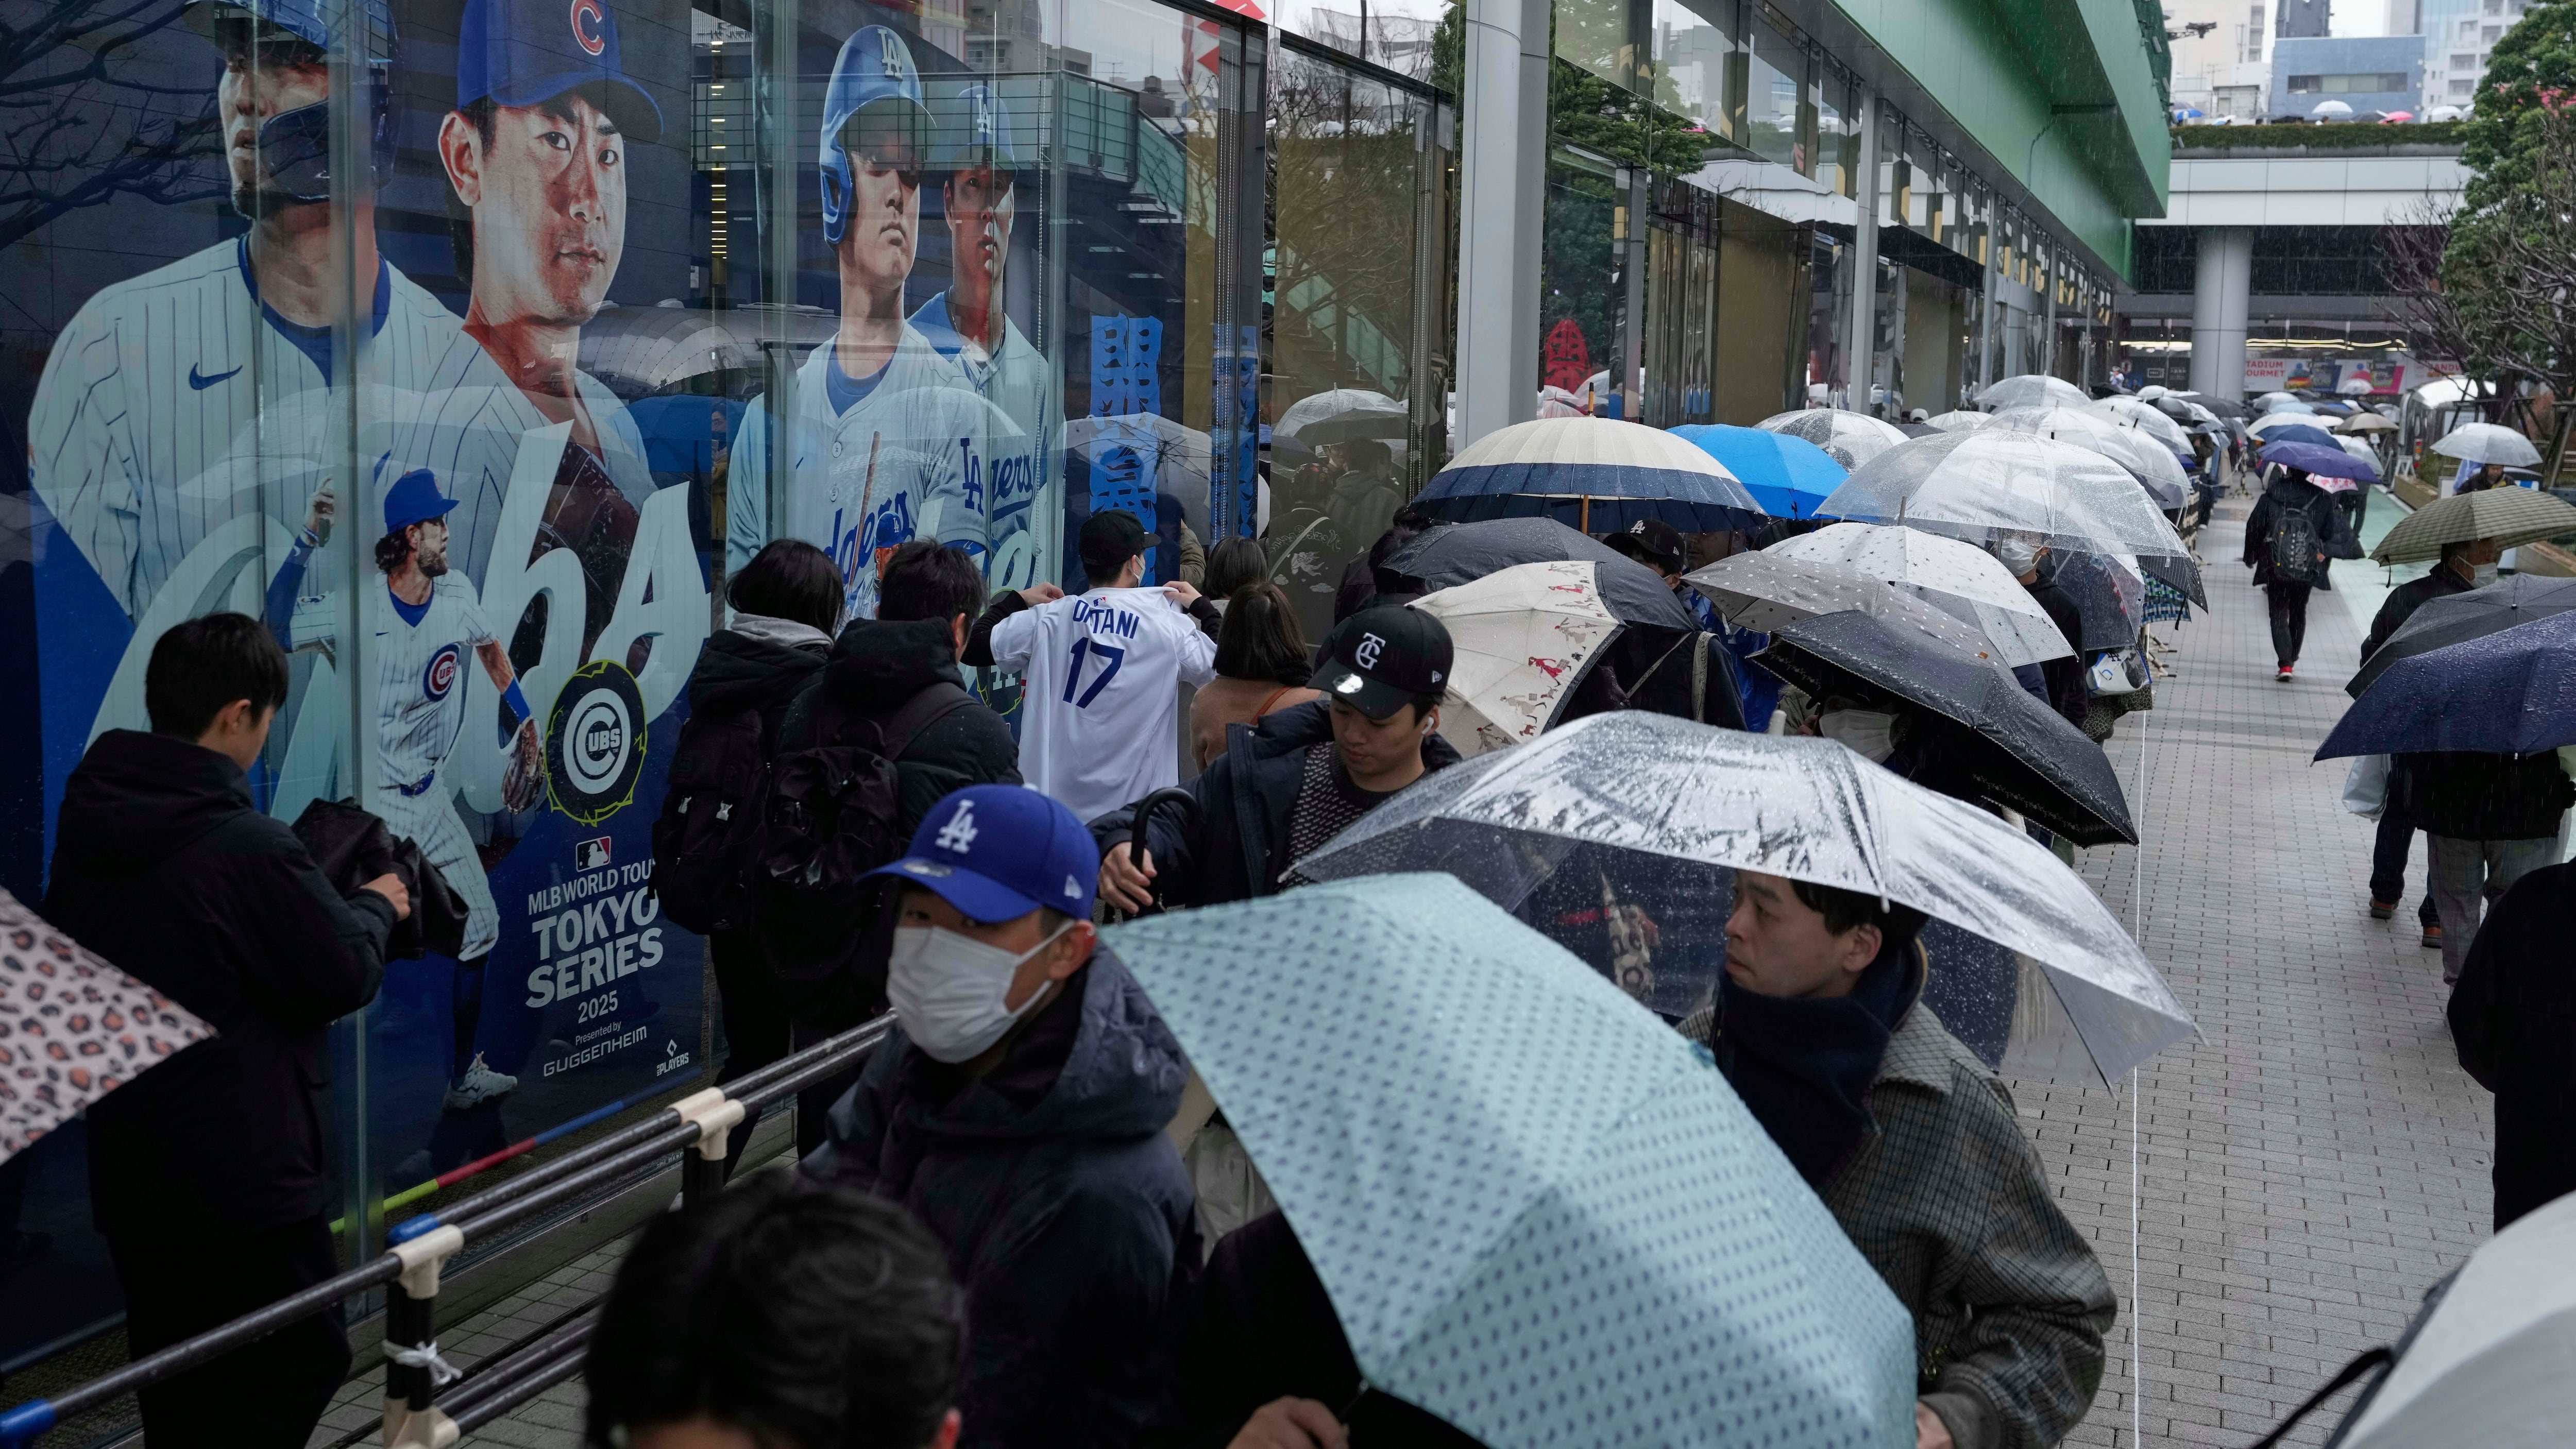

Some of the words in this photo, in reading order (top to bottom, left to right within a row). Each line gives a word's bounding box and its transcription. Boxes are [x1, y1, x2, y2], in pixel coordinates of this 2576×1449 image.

[1630, 520, 1646, 534] LA
[1062, 637, 1125, 709] 17
[935, 799, 978, 854] LA
[529, 885, 561, 915] MLB
[563, 868, 618, 903] WORLD
[532, 886, 659, 961] TOKYO
[526, 927, 664, 1008] SERIES
[578, 990, 618, 1024] 2025
[544, 1026, 647, 1077] GUGGENHEIM
[575, 1022, 612, 1046] Presented
[613, 1021, 621, 1031] by
[659, 1052, 689, 1075] PLAYERS
